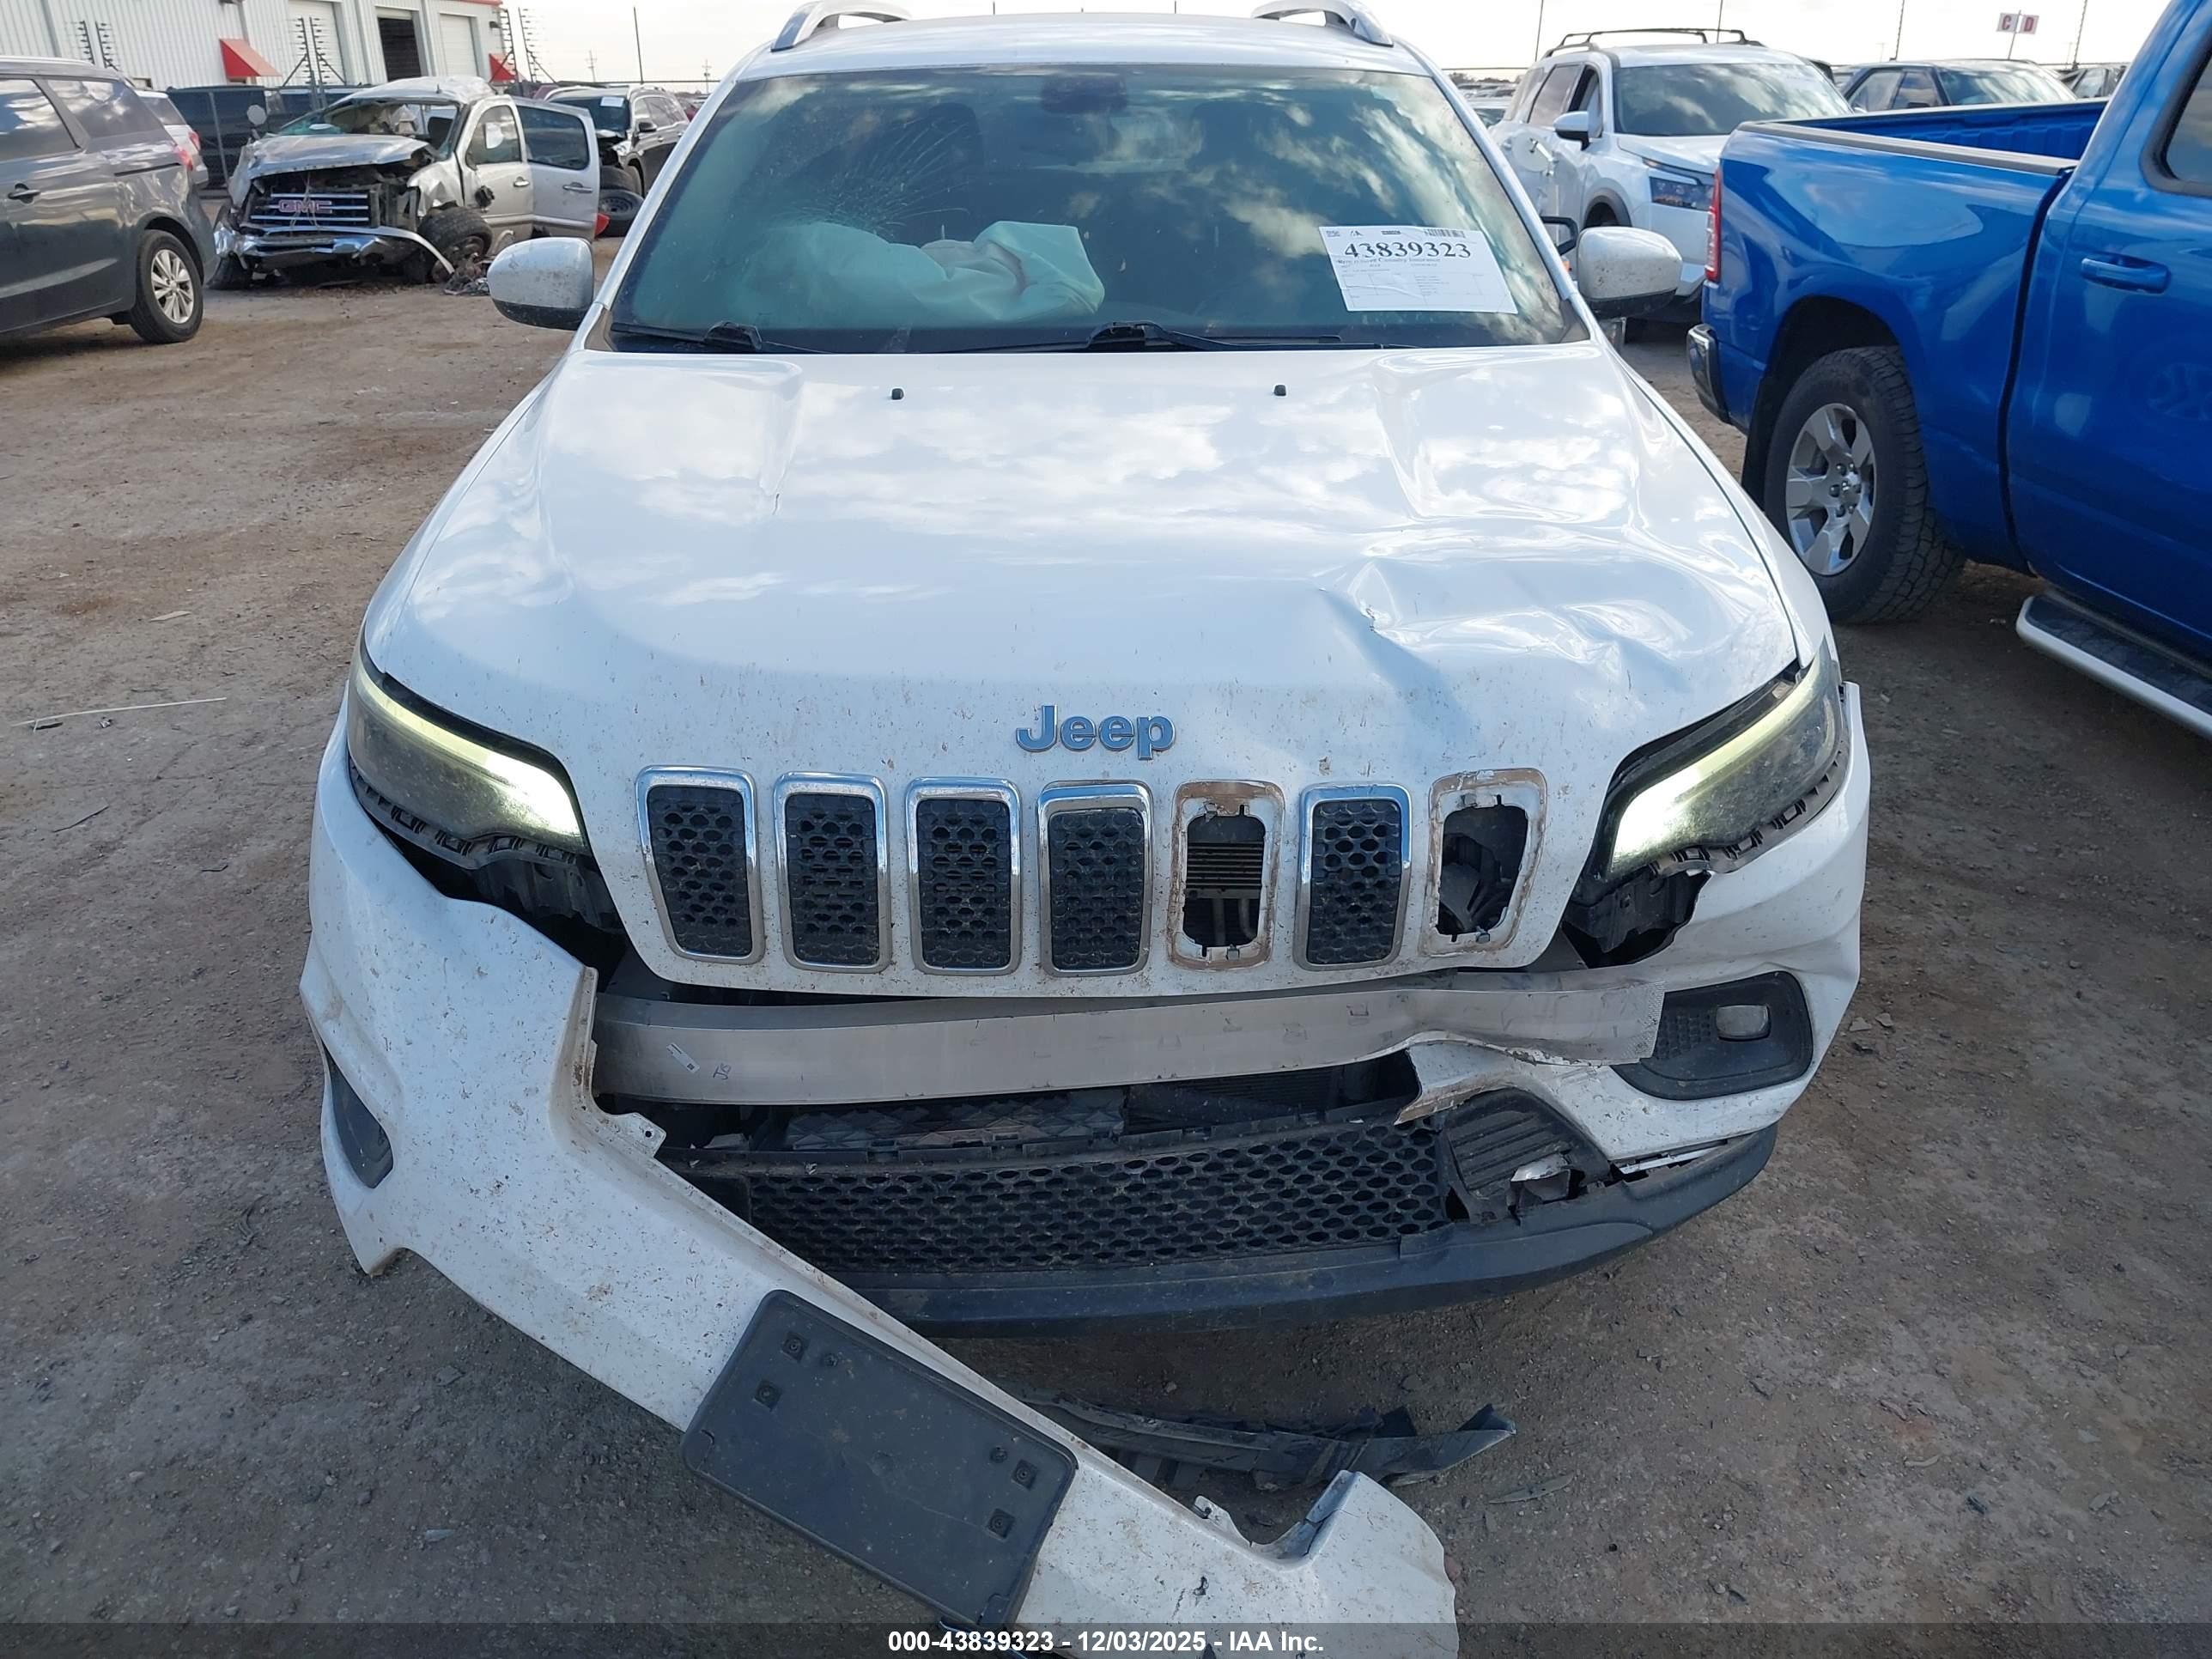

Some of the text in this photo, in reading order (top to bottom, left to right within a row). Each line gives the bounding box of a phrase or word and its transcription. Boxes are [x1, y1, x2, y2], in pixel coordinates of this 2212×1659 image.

[2002, 15, 2012, 31] C
[2024, 17, 2034, 32] D
[278, 199, 332, 214] GMC
[1345, 242, 1471, 258] 43839323
[1016, 704, 1176, 760] Jeep
